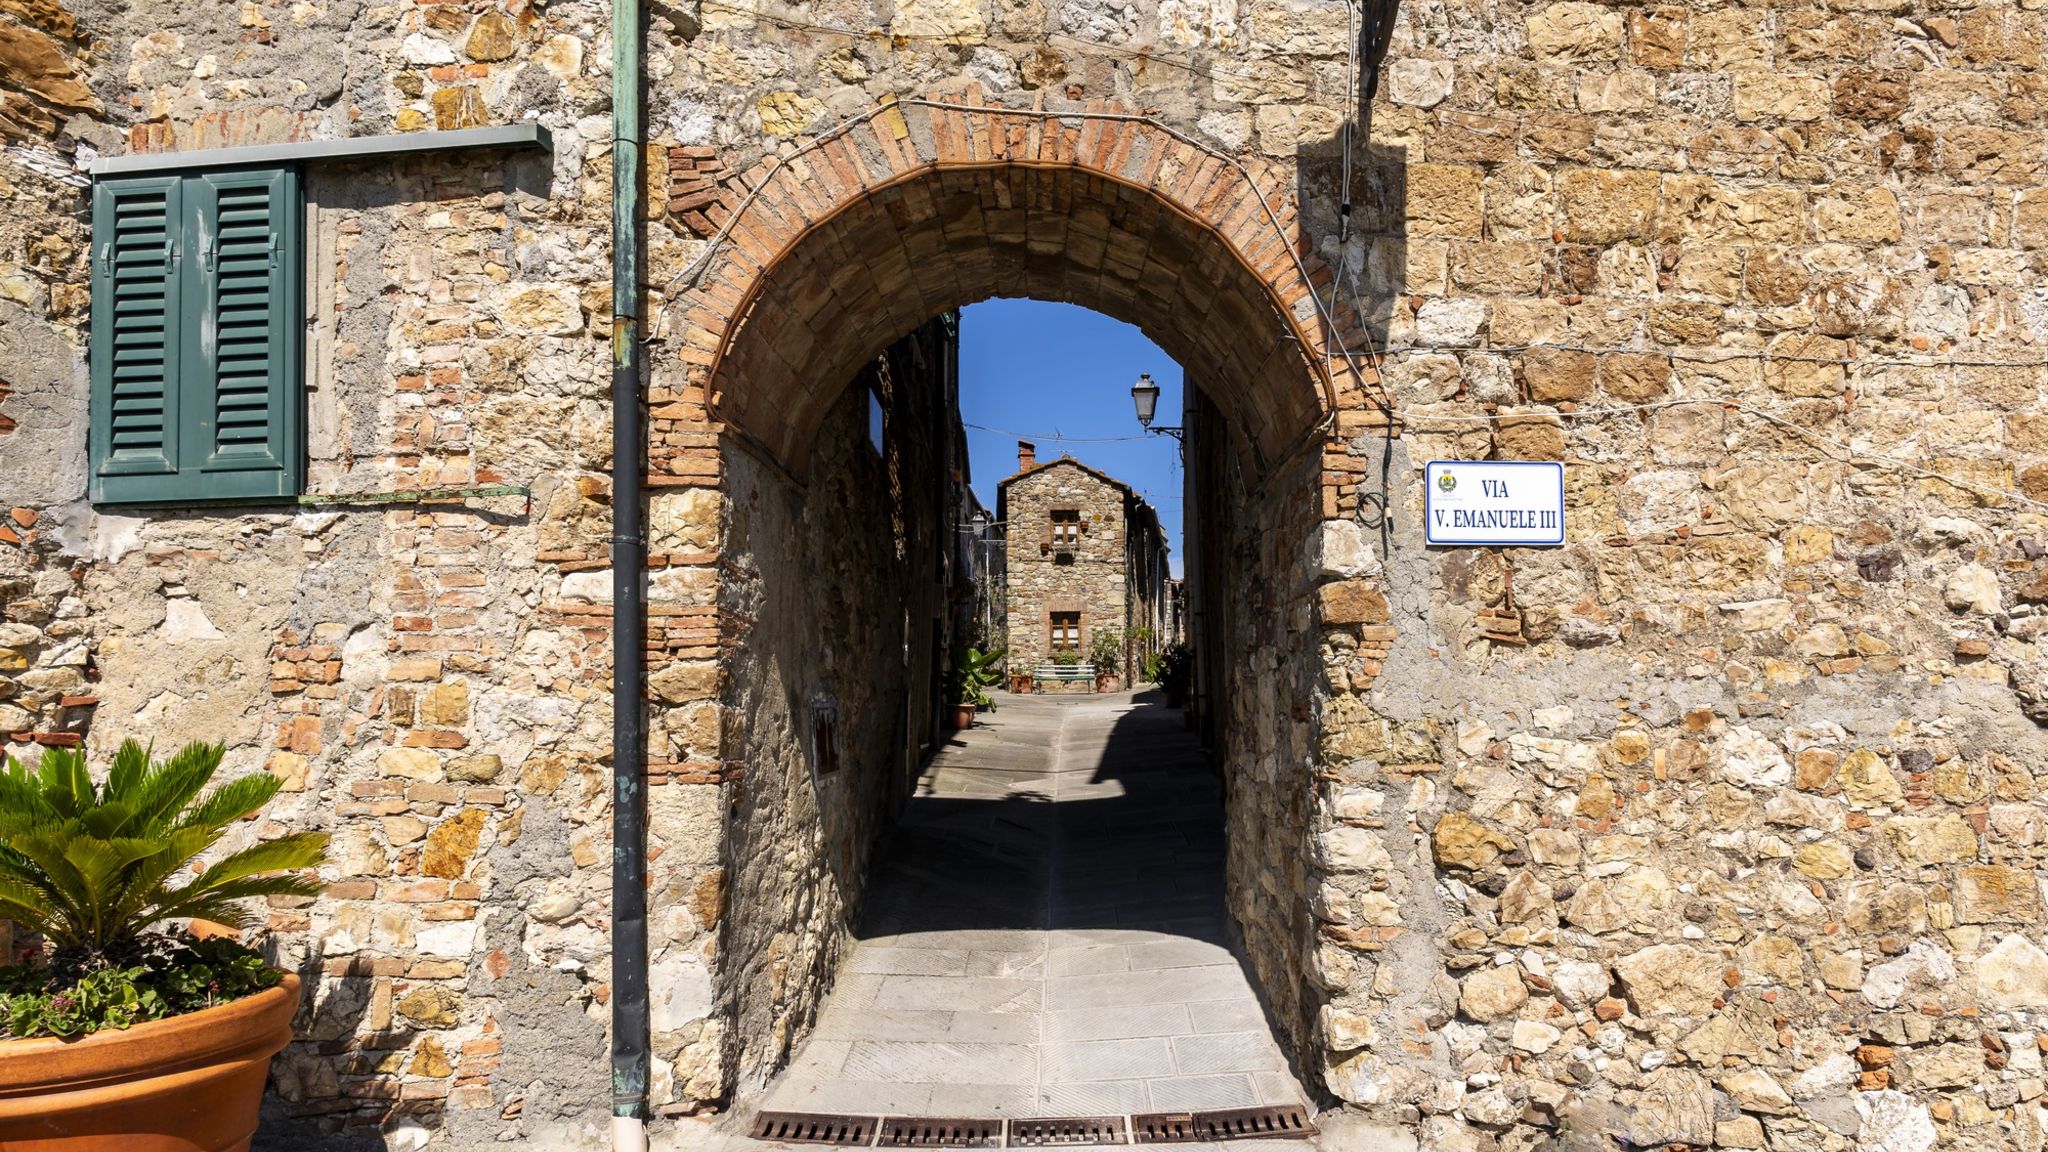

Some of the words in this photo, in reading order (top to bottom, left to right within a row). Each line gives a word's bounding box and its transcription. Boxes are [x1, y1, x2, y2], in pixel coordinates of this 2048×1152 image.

[1481, 480, 1509, 498] VIA
[1435, 509, 1449, 527] V.
[1453, 509, 1536, 528] EMANUELE
[1540, 510, 1557, 528] III
